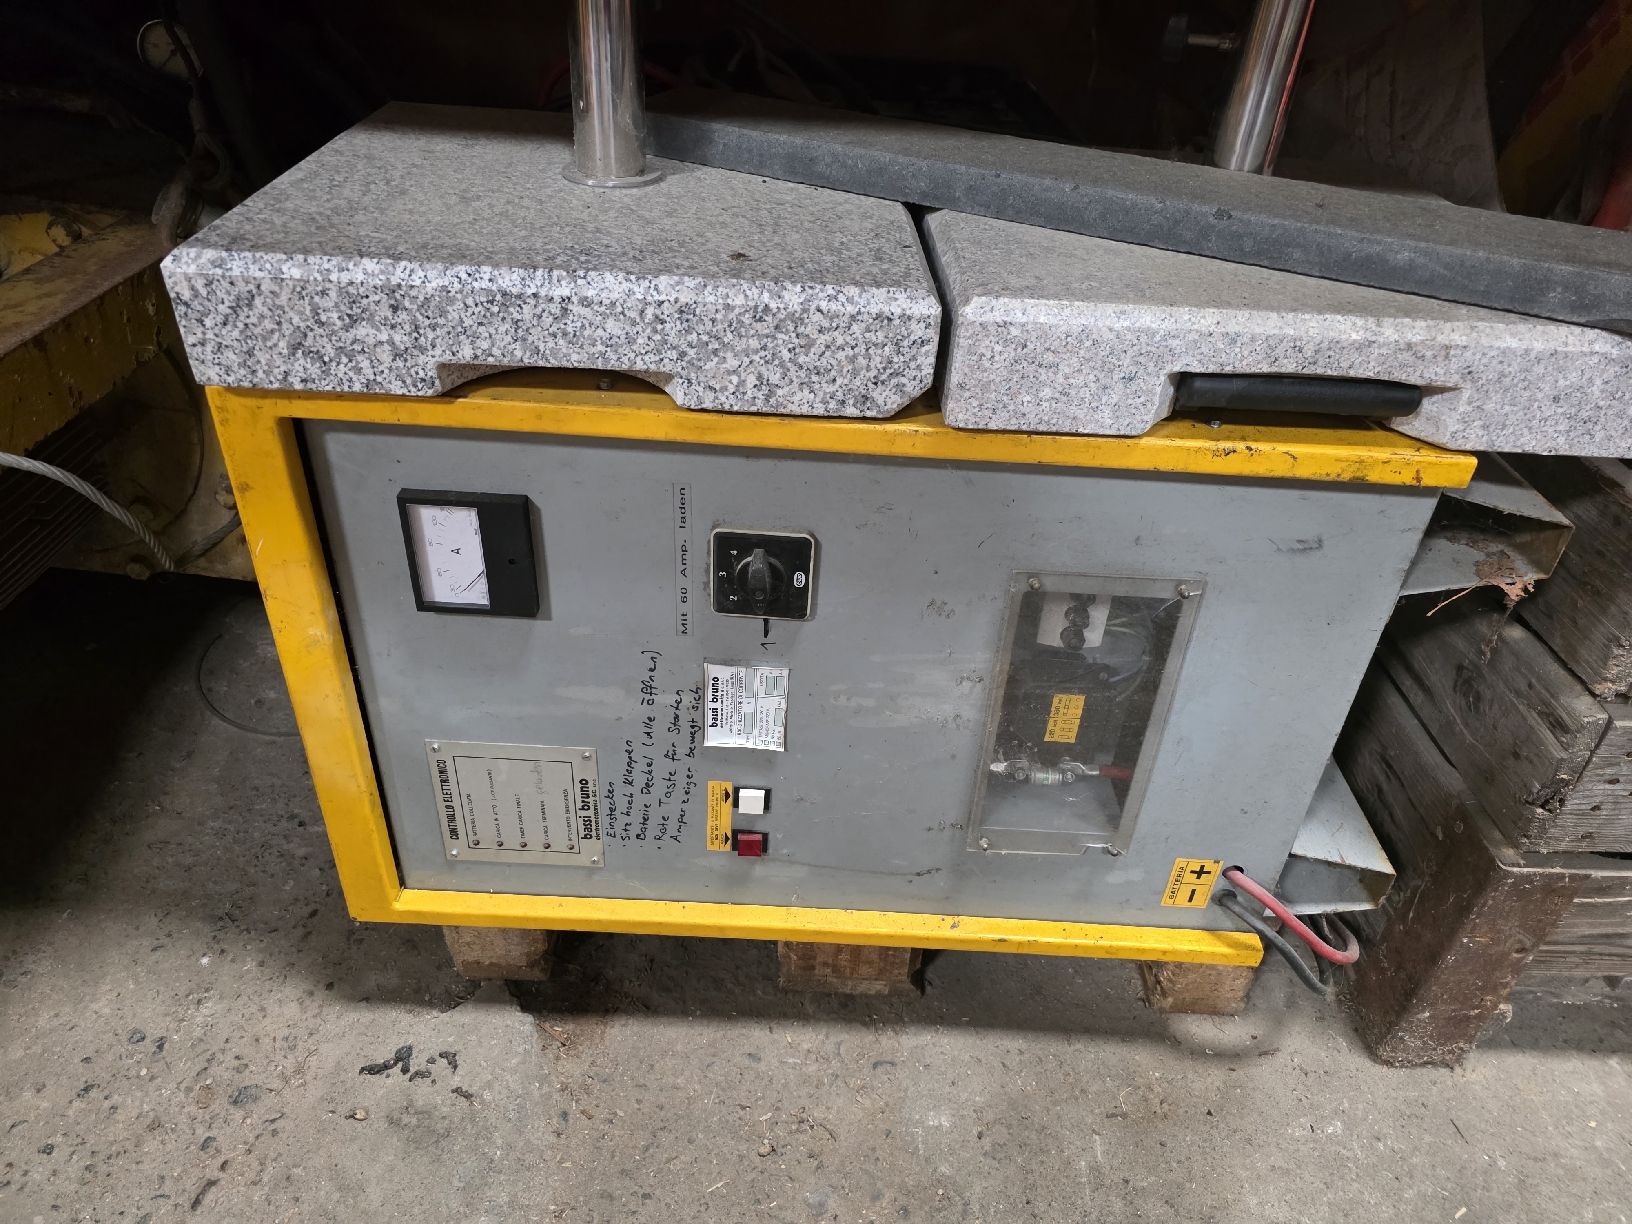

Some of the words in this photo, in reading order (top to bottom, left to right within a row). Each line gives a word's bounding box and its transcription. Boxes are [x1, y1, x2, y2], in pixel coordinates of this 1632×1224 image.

[678, 487, 686, 529] laden
[680, 539, 688, 578] Amp.
[680, 587, 688, 604] 60
[680, 611, 688, 635] Mit
[689, 686, 702, 712] sich
[708, 676, 720, 703] bruno
[708, 708, 718, 728] bassi
[664, 742, 682, 762] für
[684, 718, 702, 759] bewegt
[436, 759, 453, 803] ELETTRONICO
[640, 756, 654, 795] Deckel
[658, 769, 676, 808] Taste
[578, 778, 590, 812] bruno
[604, 782, 618, 838] Einstecken
[620, 792, 634, 816] hoch
[444, 804, 460, 840] CONTROLLO
[578, 816, 592, 840] bassi
[654, 815, 670, 841] Rote
[1168, 866, 1184, 900] BATTERIA
